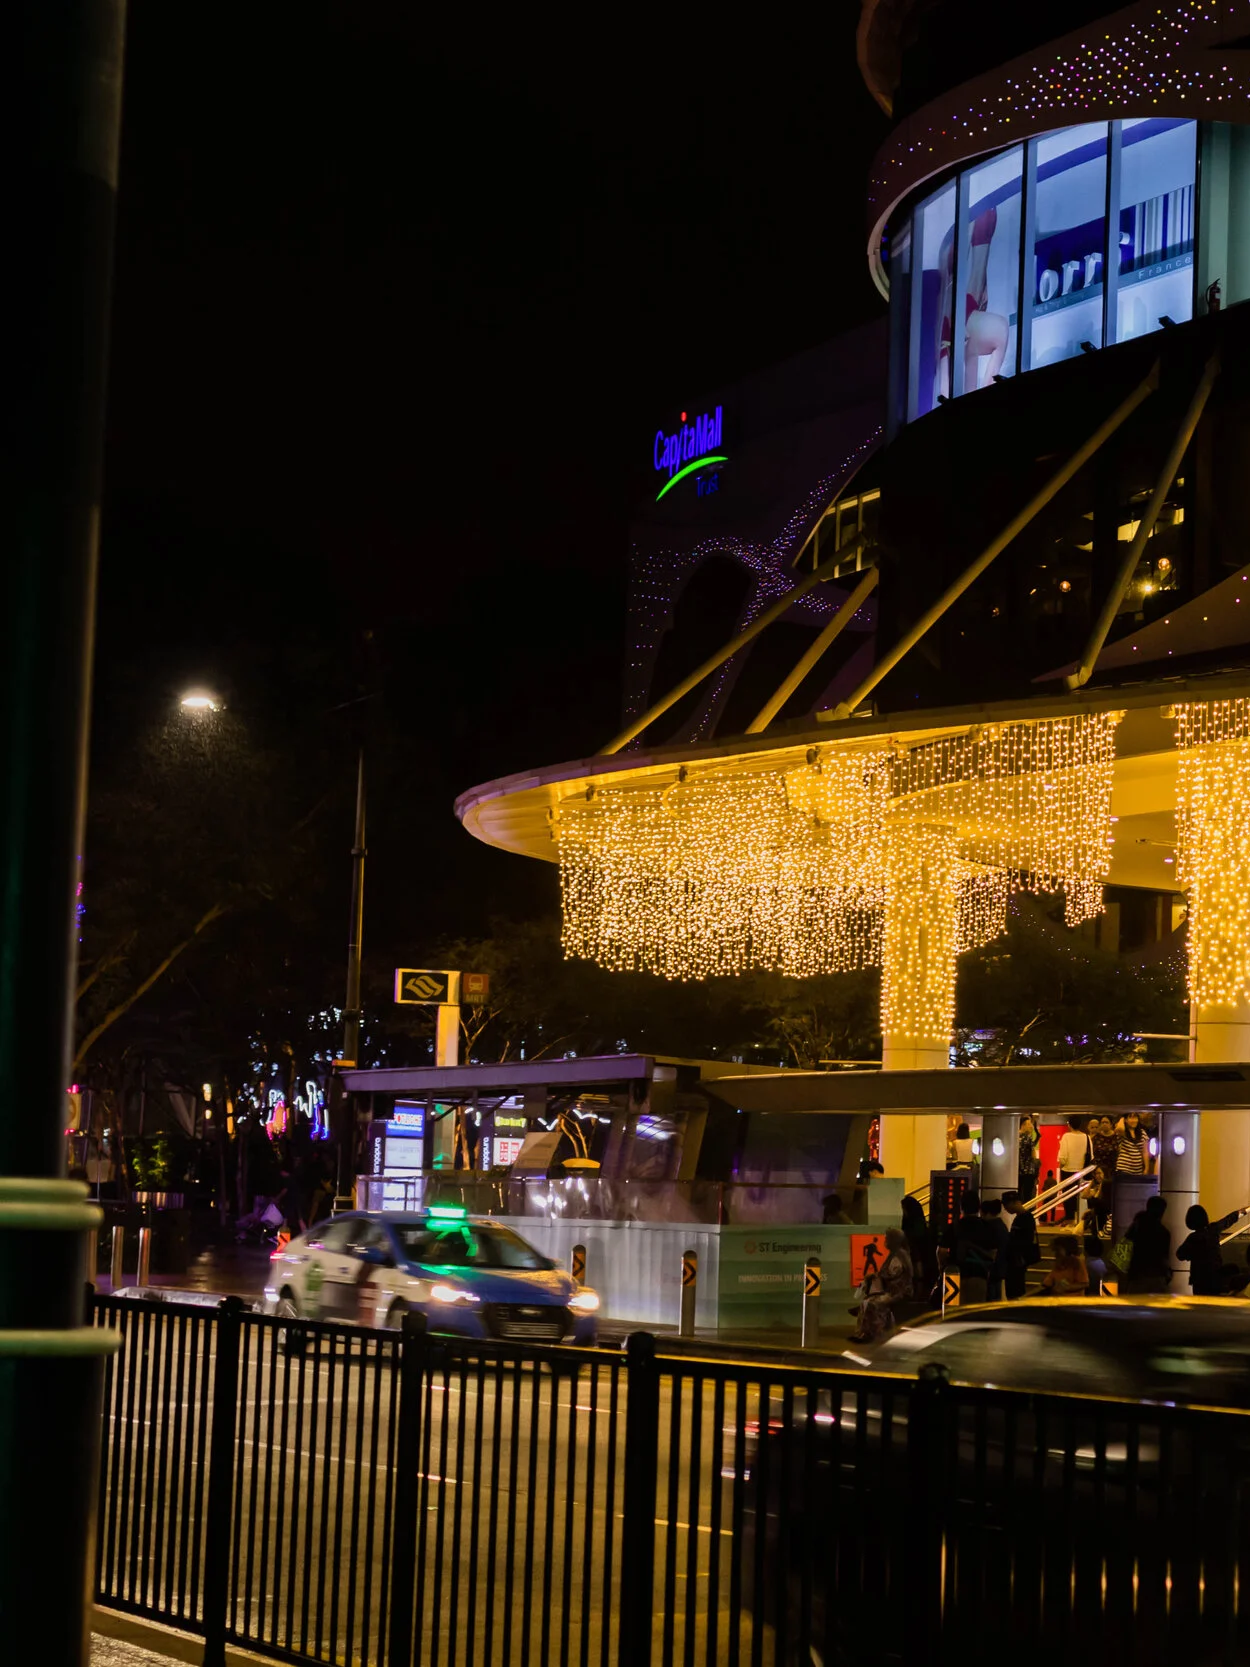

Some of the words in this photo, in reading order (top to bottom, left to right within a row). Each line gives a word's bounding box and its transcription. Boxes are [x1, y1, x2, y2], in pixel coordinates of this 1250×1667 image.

[1138, 256, 1192, 280] France
[653, 405, 724, 478] CapitaMall
[695, 472, 719, 498] Trust
[465, 994, 485, 1004] MRT
[759, 1242, 770, 1252] ST
[772, 1242, 822, 1254] Engineering
[738, 1273, 783, 1283] INNOVATION
